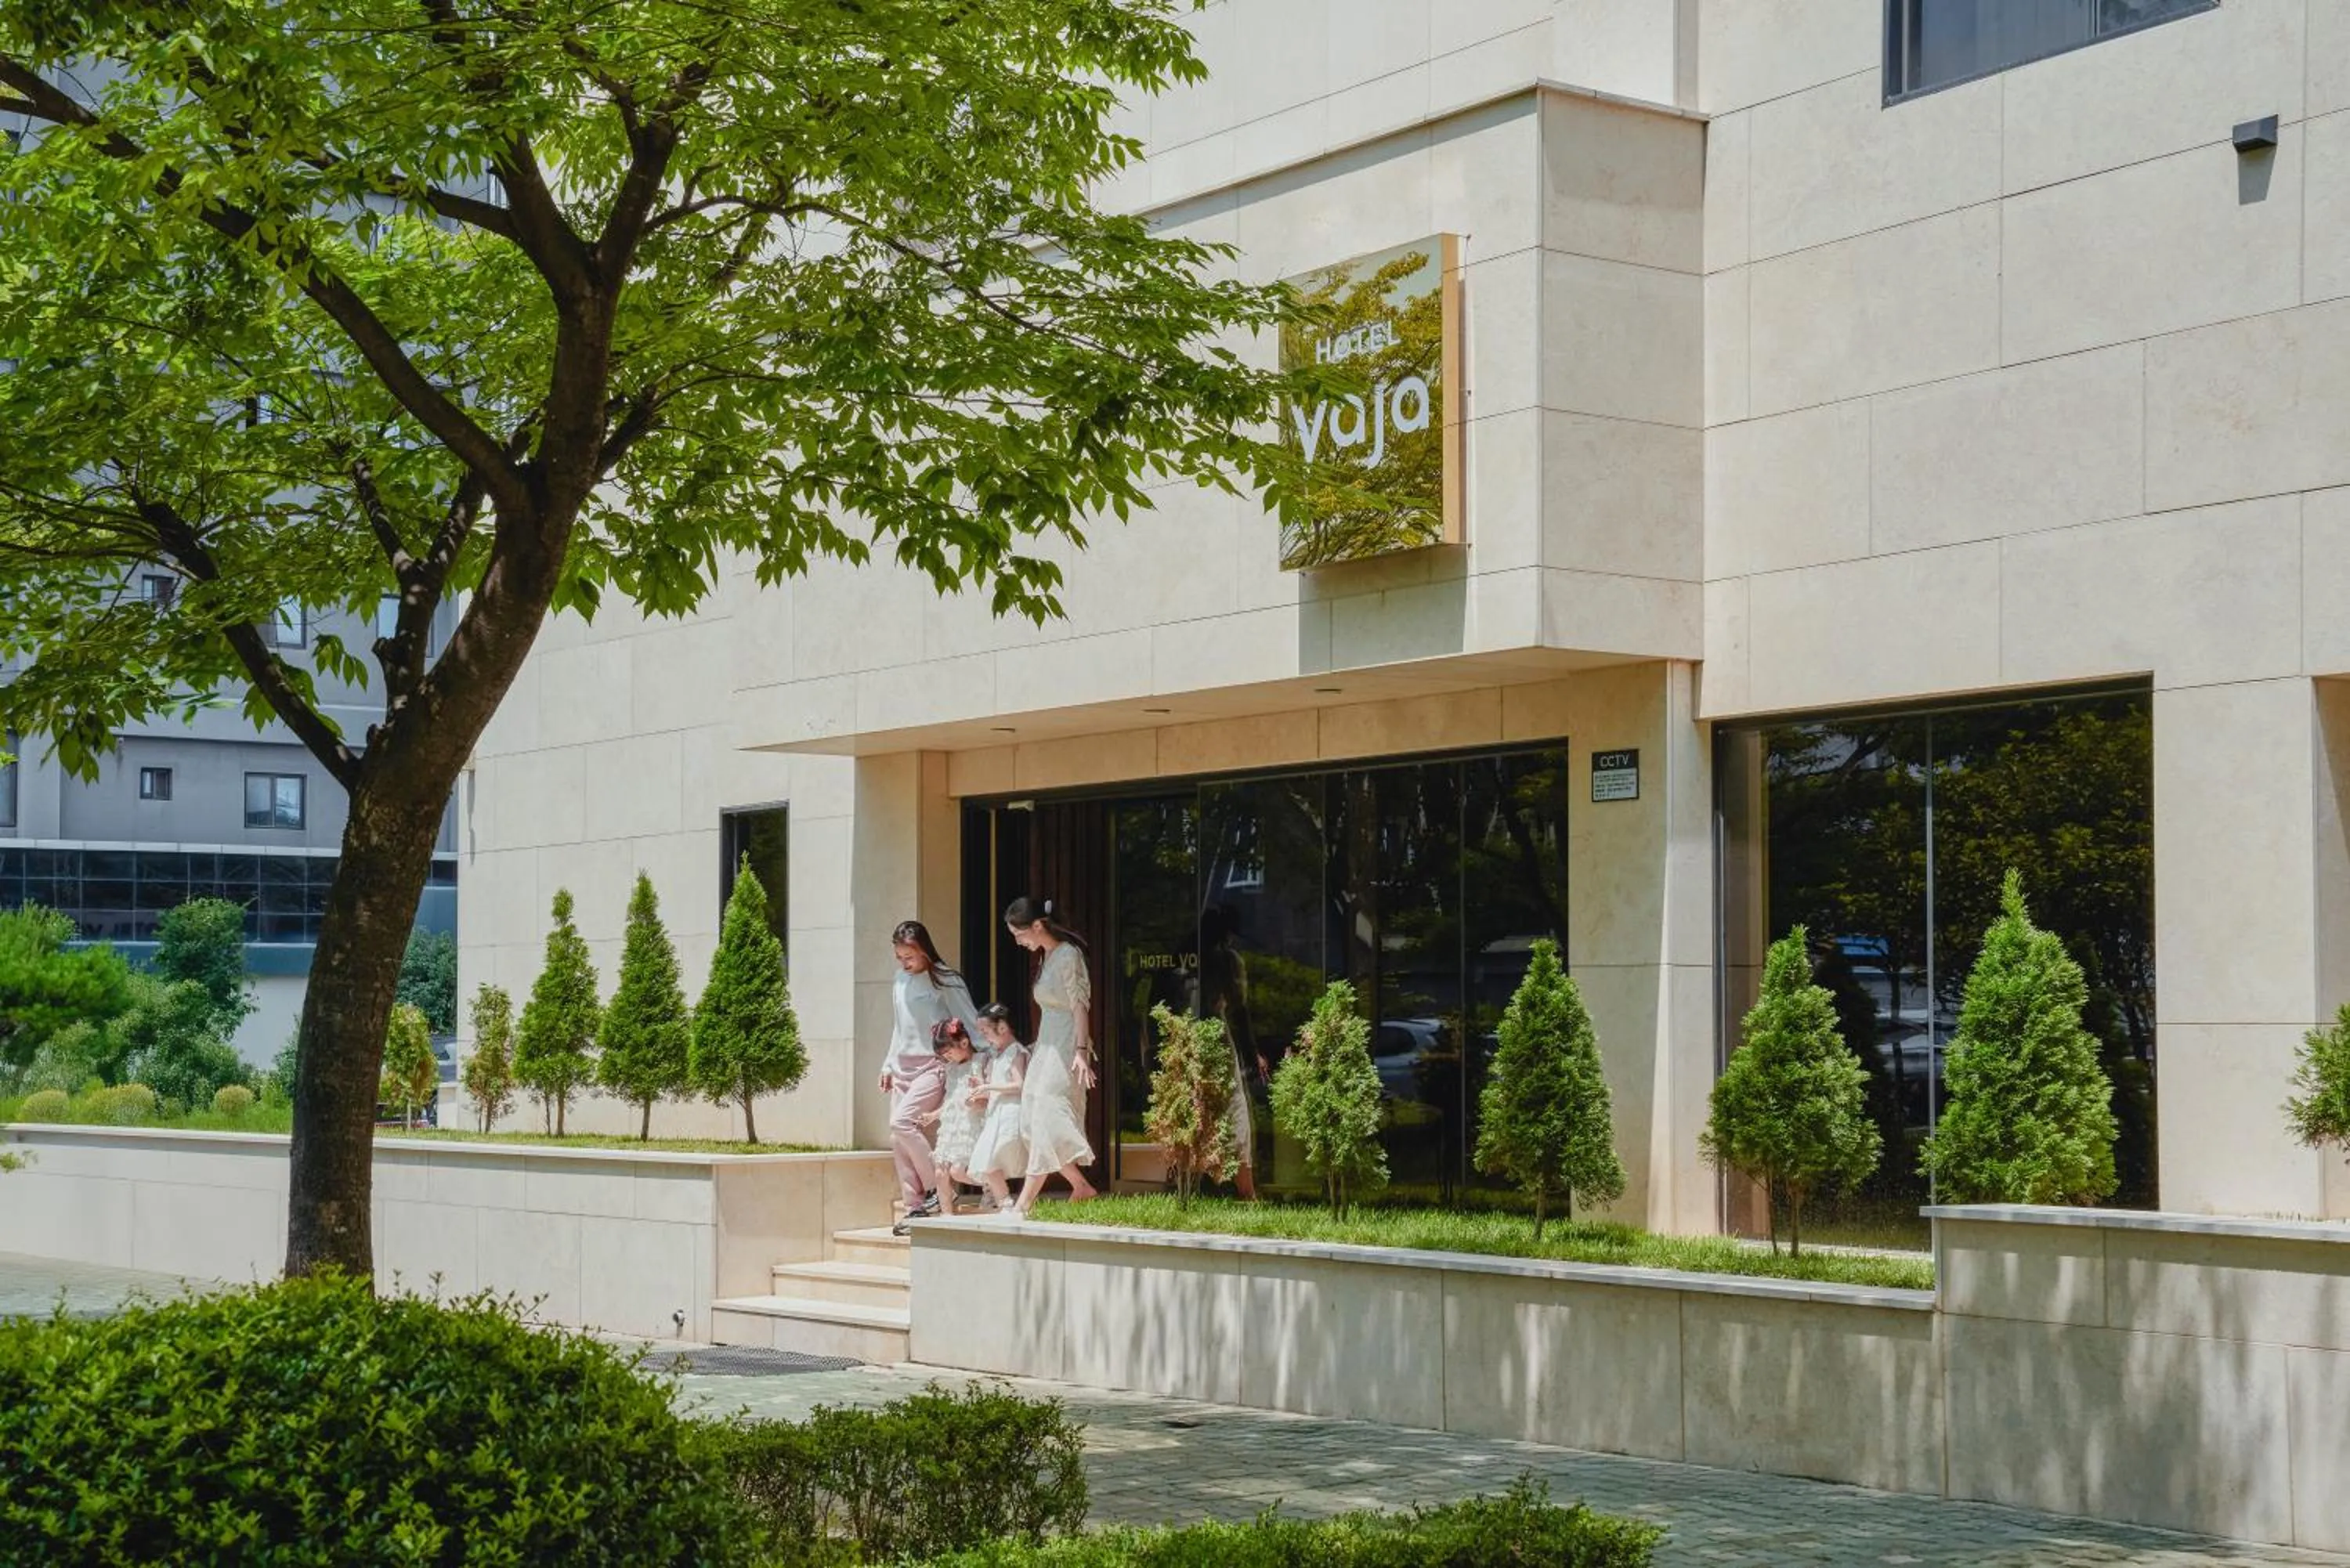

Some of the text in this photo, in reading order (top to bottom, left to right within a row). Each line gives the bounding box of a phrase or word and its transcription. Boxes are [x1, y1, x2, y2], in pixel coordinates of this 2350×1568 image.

[1316, 320, 1401, 364] HOTEL
[1600, 754, 1629, 767] CCTV
[1140, 954, 1175, 969] HOTEL
